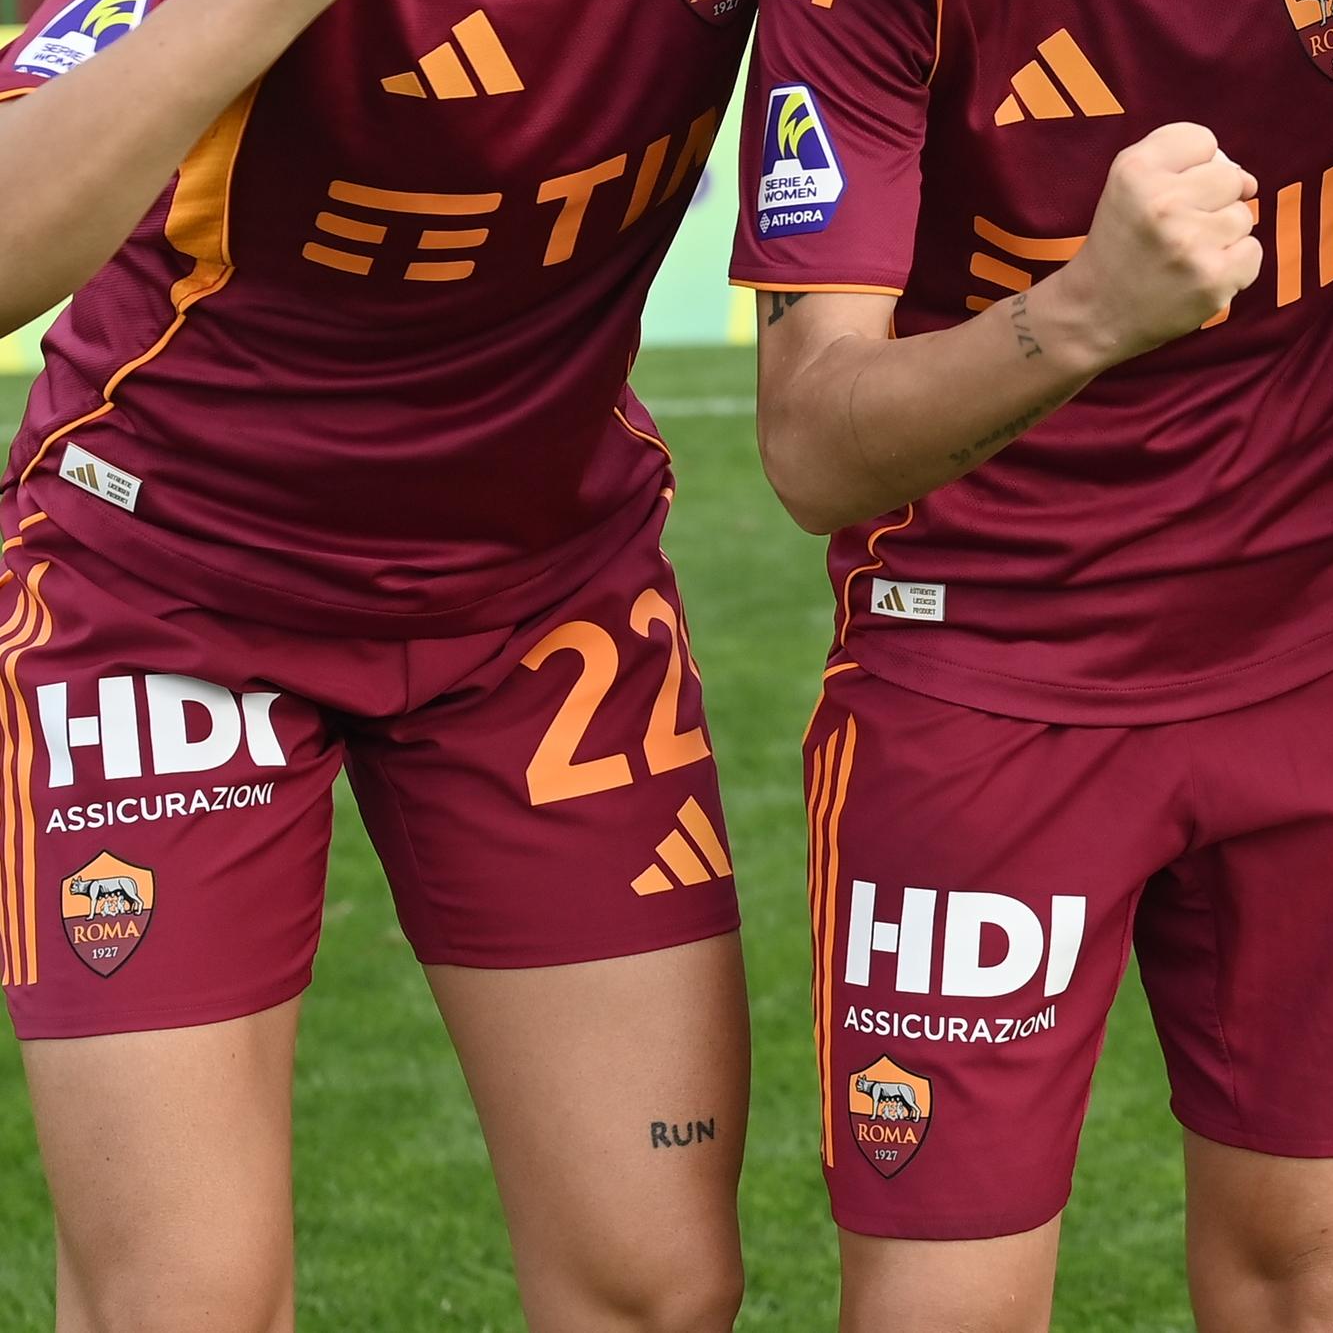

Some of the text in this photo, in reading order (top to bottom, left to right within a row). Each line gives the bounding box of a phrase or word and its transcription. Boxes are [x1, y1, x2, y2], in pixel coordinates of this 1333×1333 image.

[764, 187, 817, 203] WOMEN
[765, 175, 815, 192] SERIE A
[771, 209, 823, 227] ATHORA
[520, 588, 712, 806] 22
[36, 673, 288, 789] HDI
[45, 782, 275, 835] ASSICURAZIONI
[72, 920, 141, 944] ROMA
[844, 879, 1087, 998] HDI
[92, 946, 119, 960] 1927
[843, 1004, 1056, 1044] ASSICURAZIONI
[651, 1117, 715, 1149] RUN
[857, 1123, 919, 1144] ROMA
[875, 1149, 898, 1161] 1927
